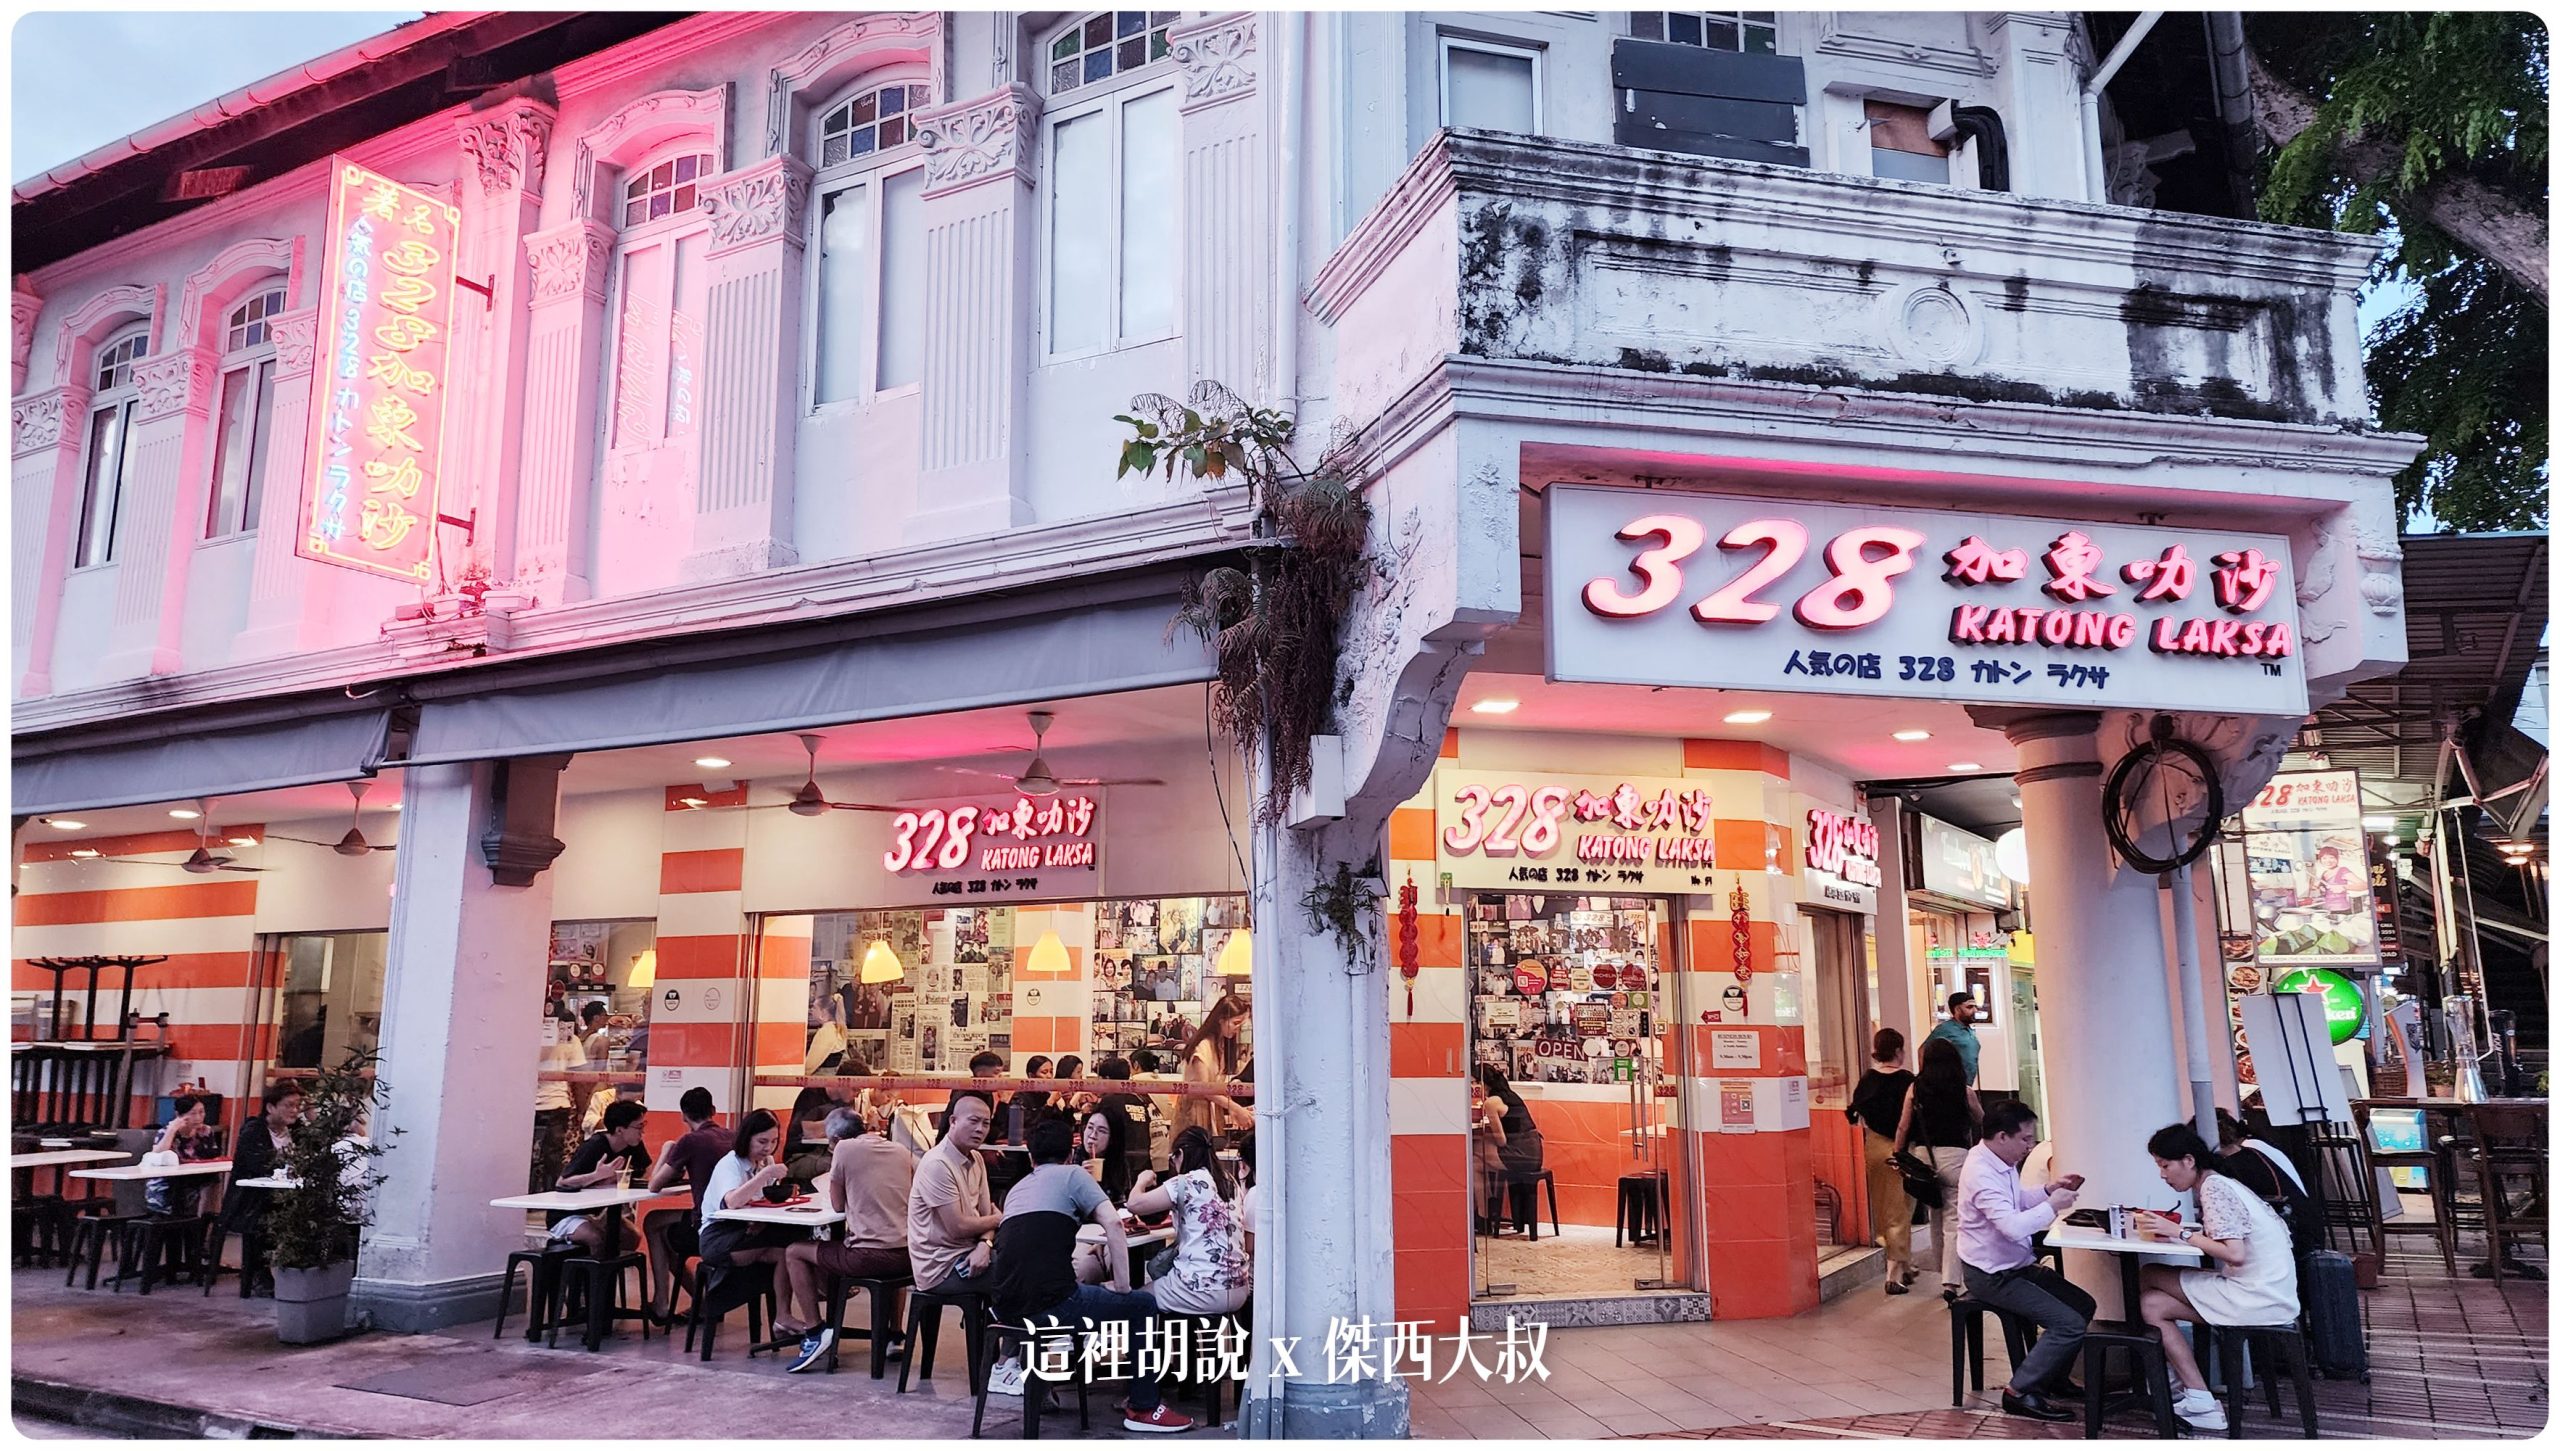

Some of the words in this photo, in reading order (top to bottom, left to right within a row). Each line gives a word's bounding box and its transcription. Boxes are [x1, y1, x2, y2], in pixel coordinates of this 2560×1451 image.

[1582, 514, 1928, 631] 328
[1941, 531, 2282, 615] 加東叻沙
[1948, 603, 2138, 649] KATONG
[2148, 615, 2294, 660] LAKSA
[1783, 650, 1882, 680] 人気の店
[1898, 655, 1956, 682] 328
[1971, 659, 2032, 685] カトン
[2047, 663, 2110, 690] ラクサ
[2261, 663, 2282, 677] TM
[1573, 783, 1713, 836] 加東叻沙
[2247, 784, 2295, 809] 28
[2297, 795, 2331, 807] KATONG
[982, 796, 1097, 841] 加東叻沙
[1443, 784, 1572, 859] 328
[883, 806, 981, 872] 328
[980, 846, 1043, 872] KATONG
[1044, 841, 1096, 868] LAKSA
[1577, 835, 1652, 866] KATONG
[1657, 837, 1716, 867] LAKSA
[1805, 808, 1844, 874] 328
[967, 880, 987, 894] 328
[1556, 867, 1579, 882] 328
[1538, 1041, 1586, 1061] OPEN
[1656, 1085, 1677, 1097] 328
